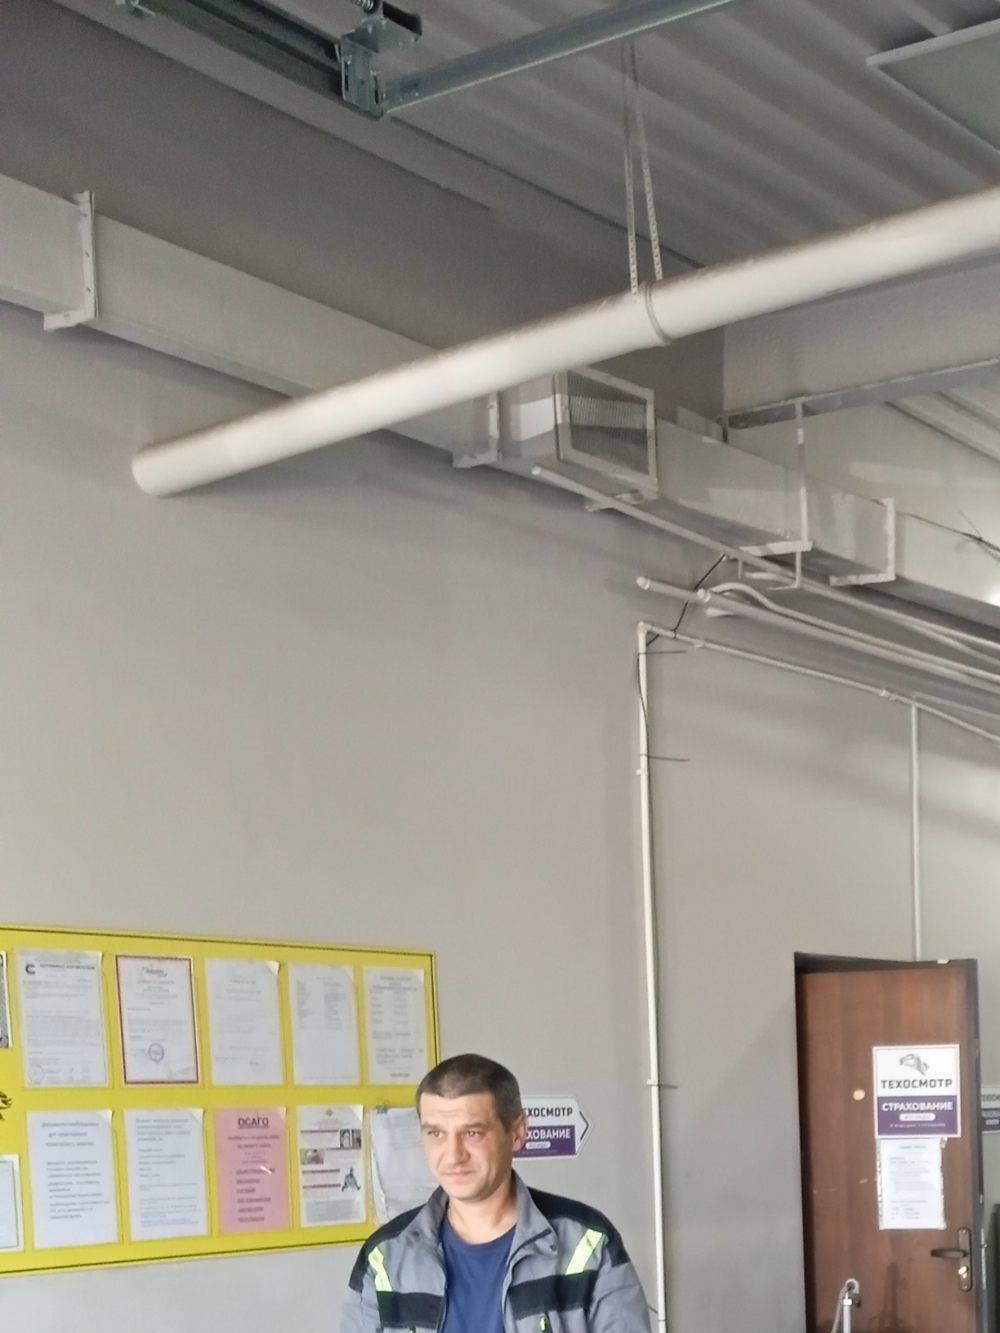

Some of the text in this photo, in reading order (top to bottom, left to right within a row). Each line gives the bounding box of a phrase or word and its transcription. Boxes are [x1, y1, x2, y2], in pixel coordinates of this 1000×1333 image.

[881, 1078, 953, 1089] ТЕХОСМОТР
[525, 1106, 573, 1118] ХОСМОТР
[881, 1101, 954, 1112] СТРАХОВАНИЕ
[237, 1116, 270, 1128] ОСАГО
[526, 1128, 572, 1140] ХОВАНИЕ
